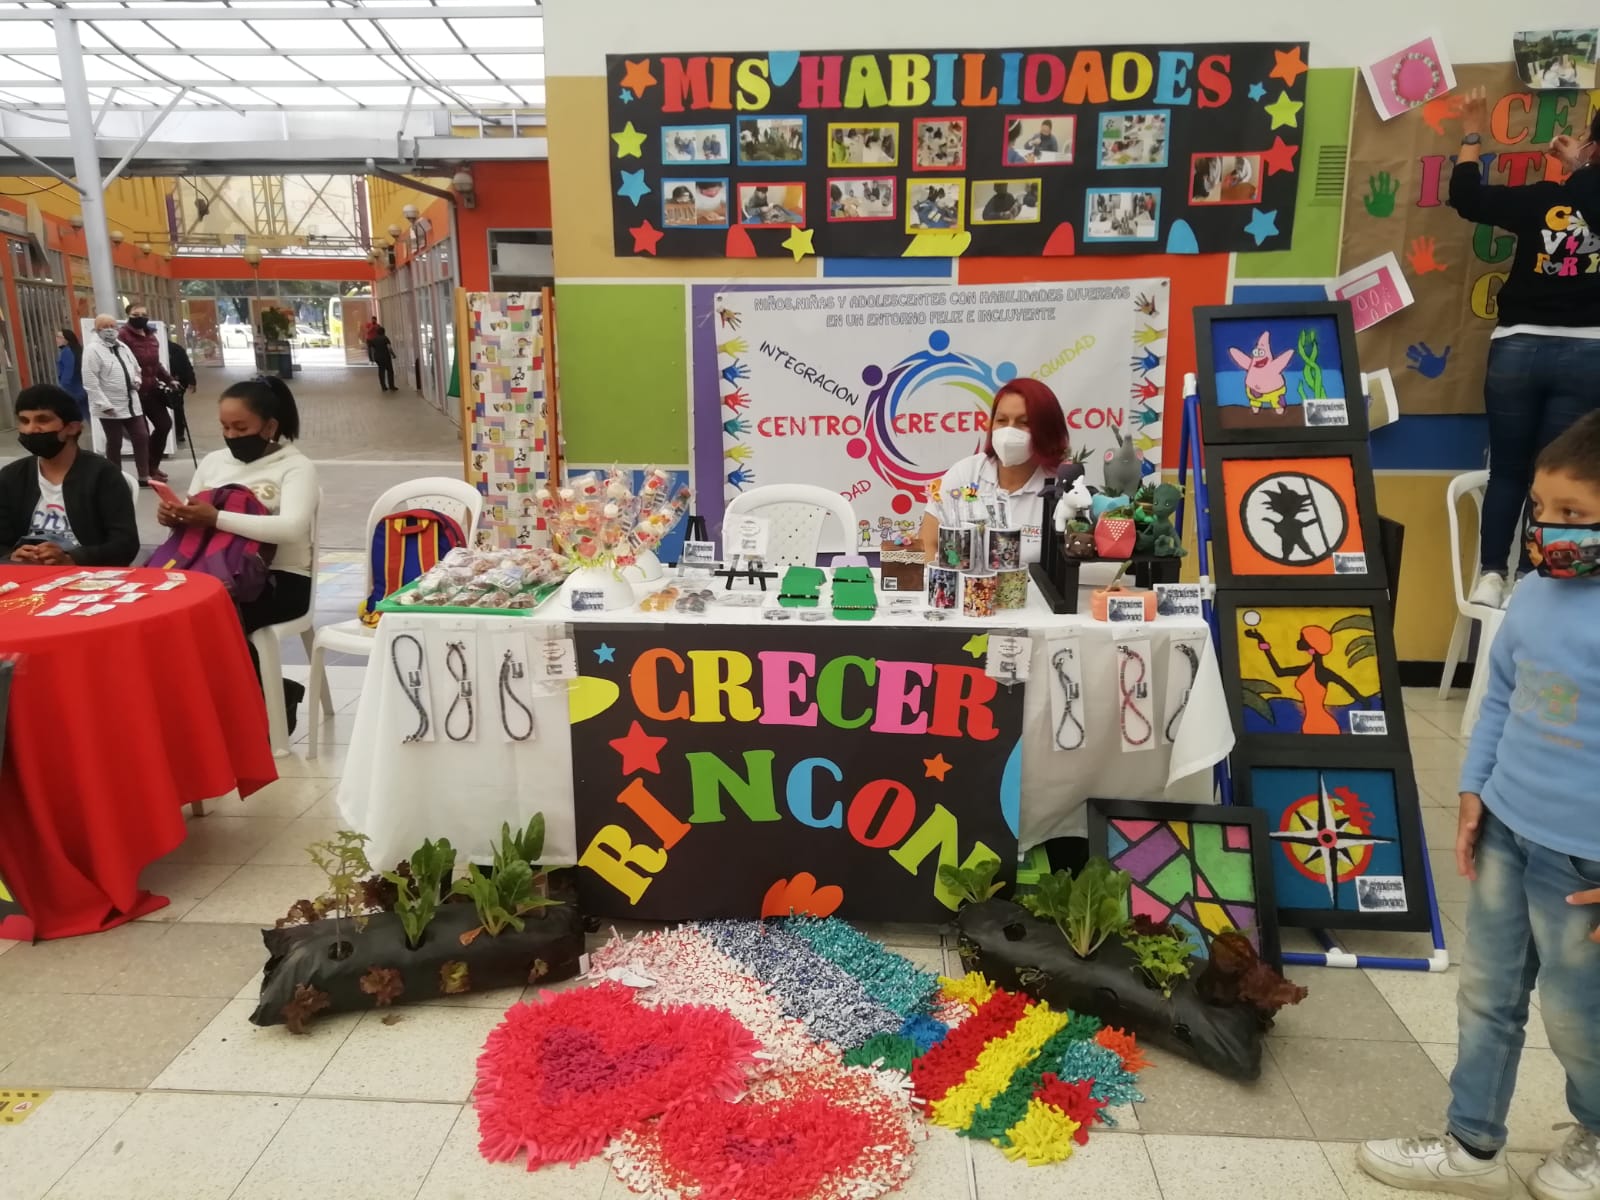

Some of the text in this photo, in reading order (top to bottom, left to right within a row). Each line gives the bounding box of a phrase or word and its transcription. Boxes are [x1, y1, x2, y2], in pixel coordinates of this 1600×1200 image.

[659, 49, 1233, 112] MIS HABILIDADES
[826, 307, 1055, 327] EN UN ENTORNO FELIZ E INCLUYENTE
[837, 296, 846, 309] Y
[849, 293, 946, 308] ADOLESCENTES
[950, 291, 976, 305] CON
[979, 288, 1063, 305] HABILIDADES
[1066, 286, 1130, 301] DIVERSAS
[760, 340, 859, 406] INTEGRACION
[757, 414, 862, 438] CENTRO
[1067, 407, 1124, 430] CON
[840, 480, 872, 502] DAD
[630, 648, 1000, 741] CRECER
[578, 749, 1002, 912] RINCON
